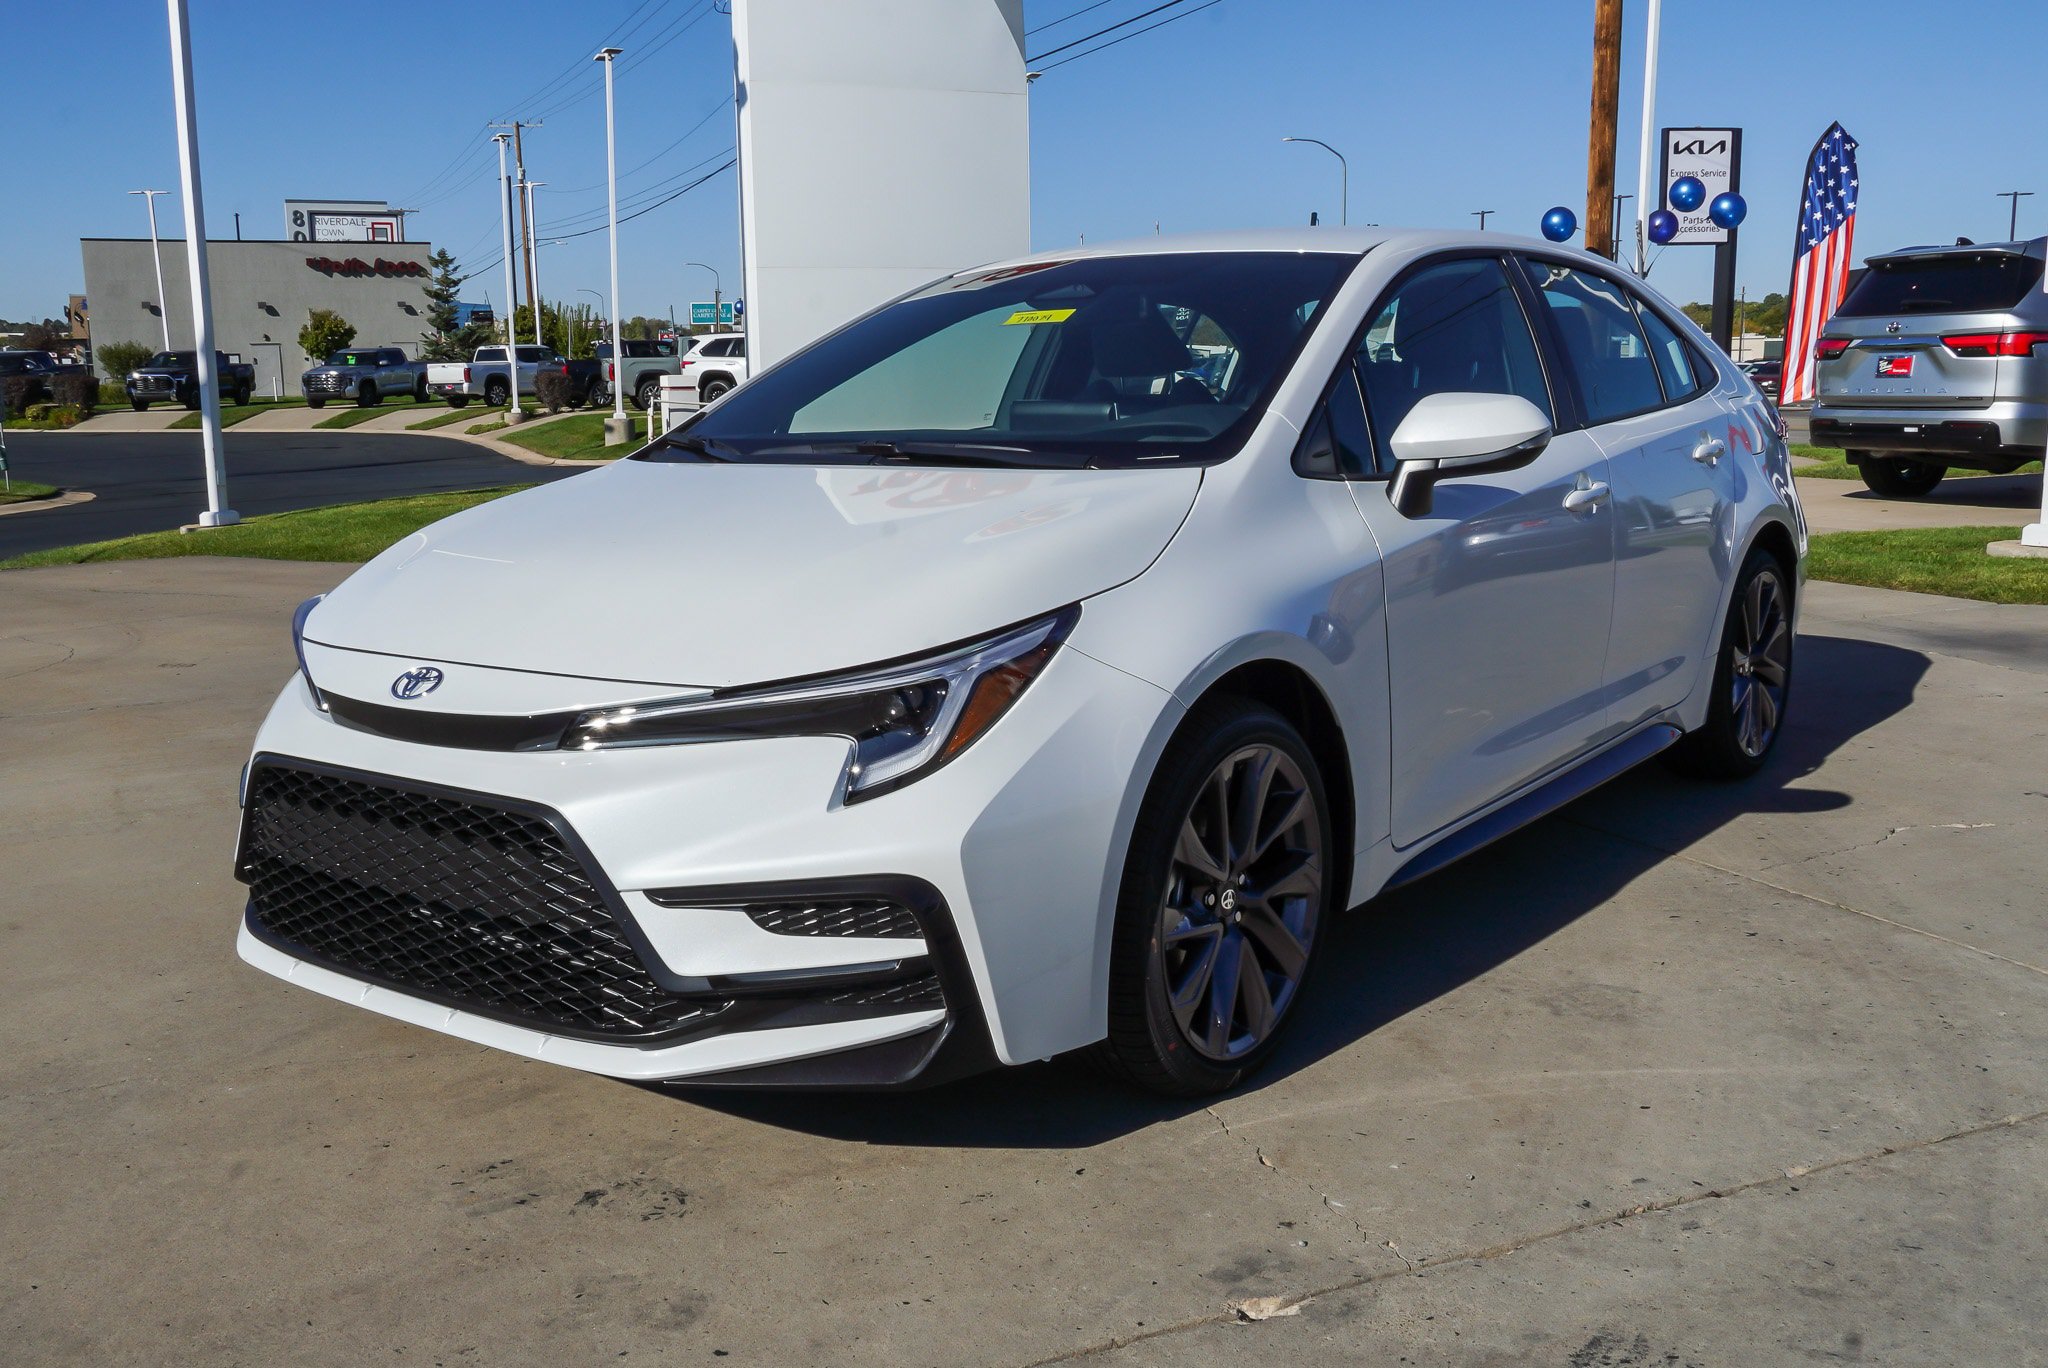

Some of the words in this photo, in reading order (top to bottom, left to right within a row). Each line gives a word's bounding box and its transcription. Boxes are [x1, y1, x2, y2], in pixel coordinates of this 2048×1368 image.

[1670, 169, 1699, 178] Express
[1700, 169, 1727, 178] Service
[315, 217, 367, 226] RIVERDALE
[1683, 216, 1704, 225] Parts
[316, 229, 345, 237] TOWN
[1676, 225, 1720, 233] ccessories
